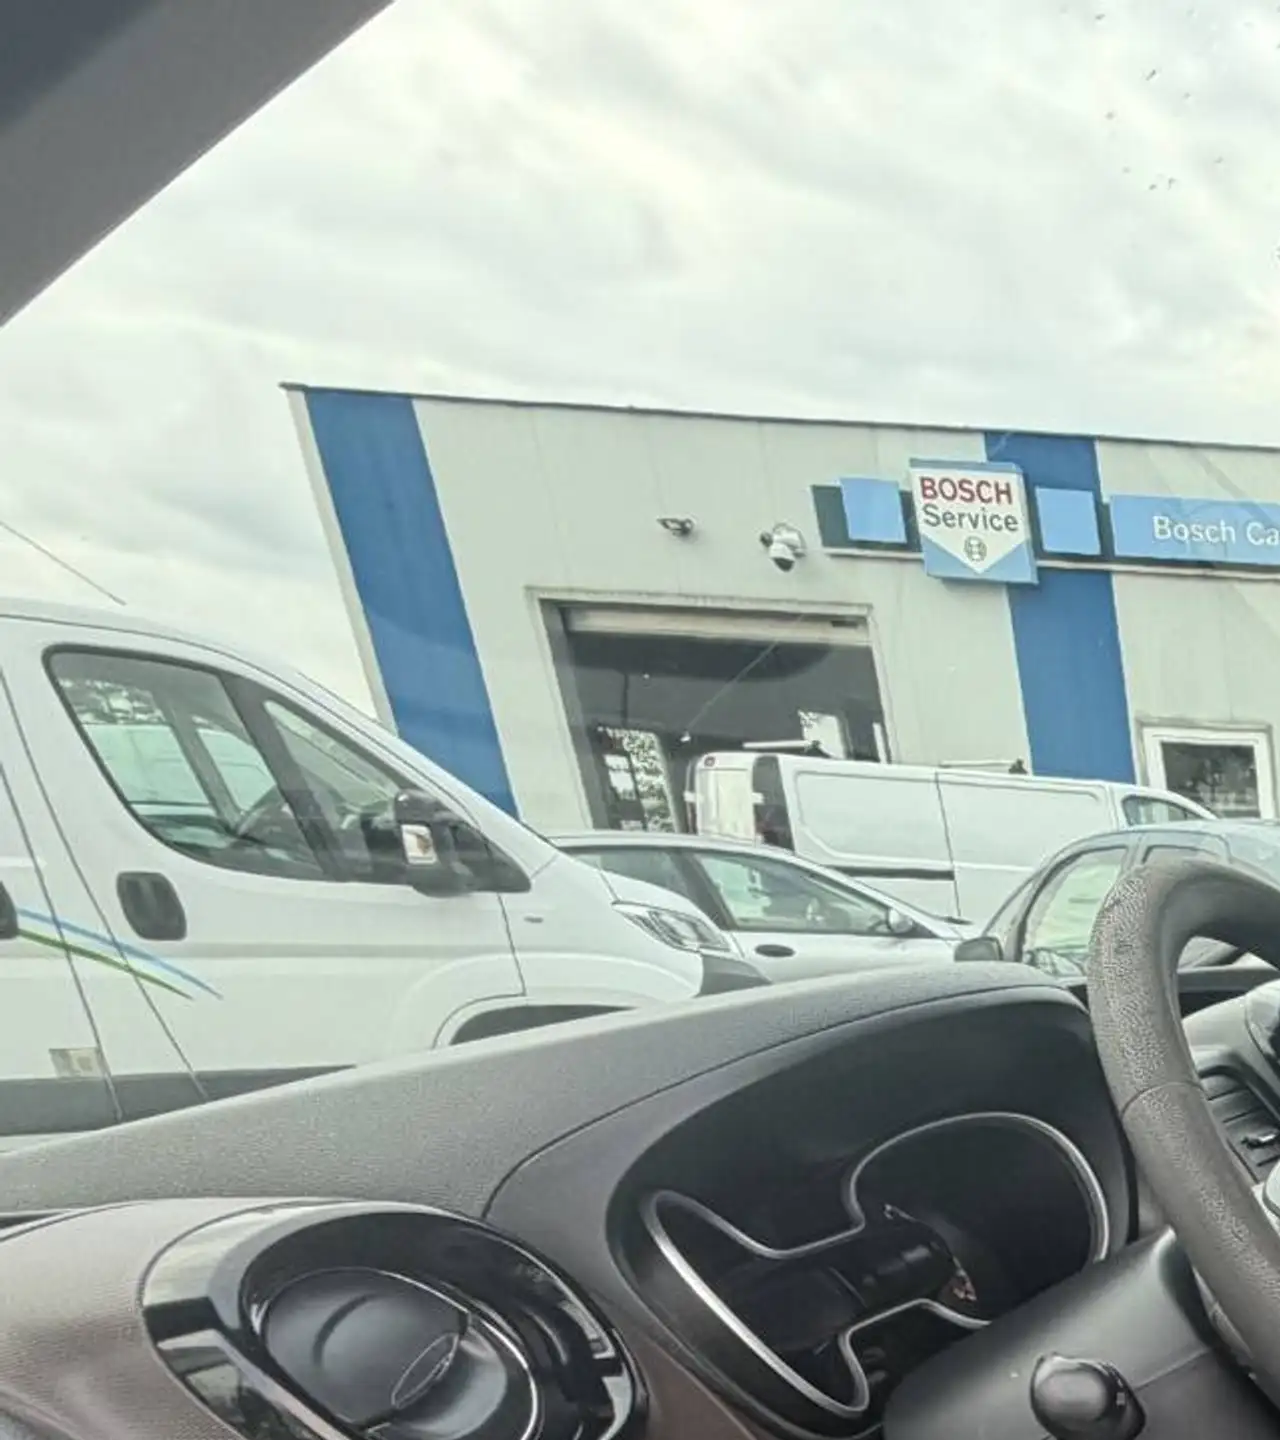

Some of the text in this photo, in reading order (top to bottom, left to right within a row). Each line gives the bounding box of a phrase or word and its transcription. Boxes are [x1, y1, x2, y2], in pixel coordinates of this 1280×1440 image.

[919, 476, 1013, 506] BOSCH
[921, 503, 1019, 532] Service
[1152, 515, 1236, 545] Bosch
